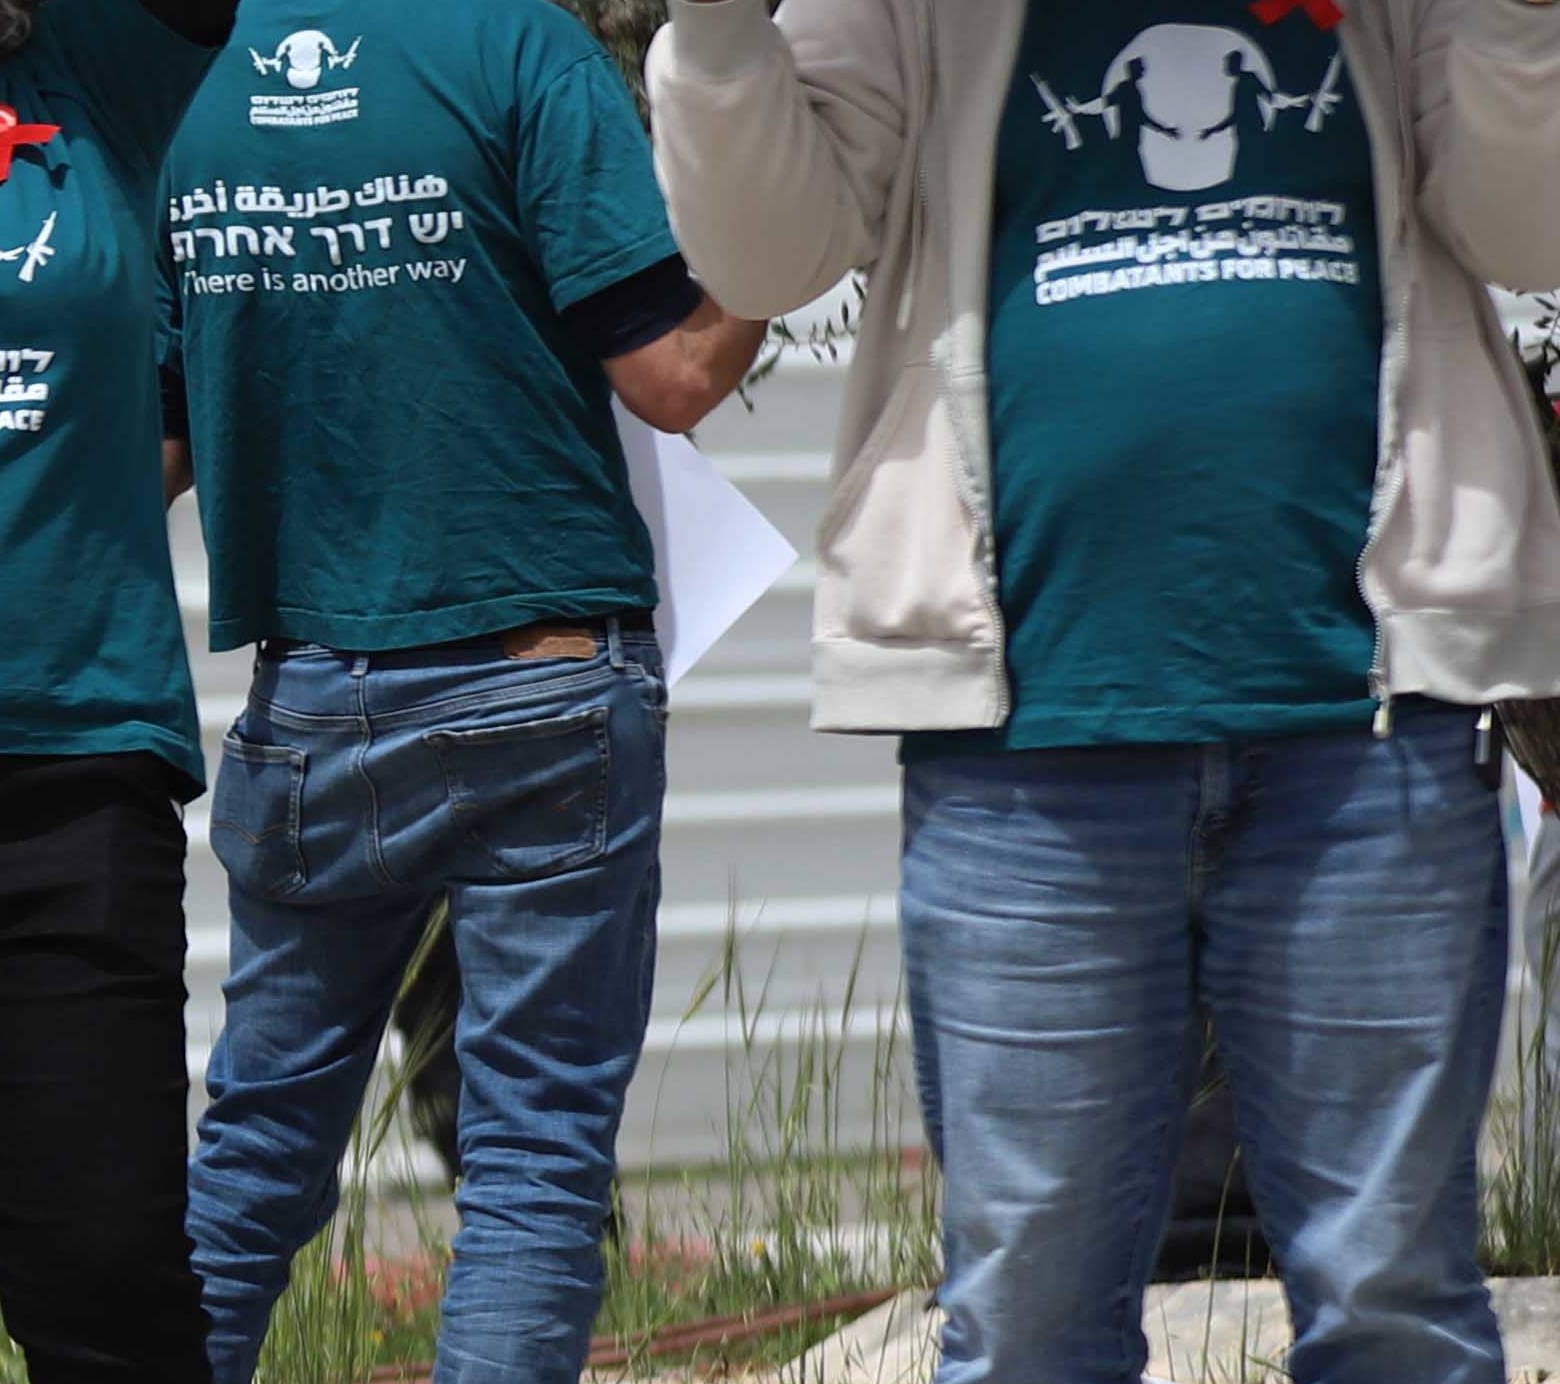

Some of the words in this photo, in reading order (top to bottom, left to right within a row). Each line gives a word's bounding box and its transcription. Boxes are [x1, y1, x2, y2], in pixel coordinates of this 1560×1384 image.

[234, 185, 350, 218] طريقة
[354, 174, 448, 206] هناك
[408, 210, 464, 243] יש
[1036, 205, 1189, 243] לשלום
[1195, 195, 1345, 225] לוחמים
[170, 225, 296, 262] אחרת
[309, 217, 392, 265] דרך
[261, 267, 286, 290] is
[292, 263, 400, 292] another
[405, 256, 467, 283] way
[1035, 260, 1217, 305] COMBATANTS
[1220, 258, 1276, 280] FOR
[1278, 258, 1359, 285] PEACE
